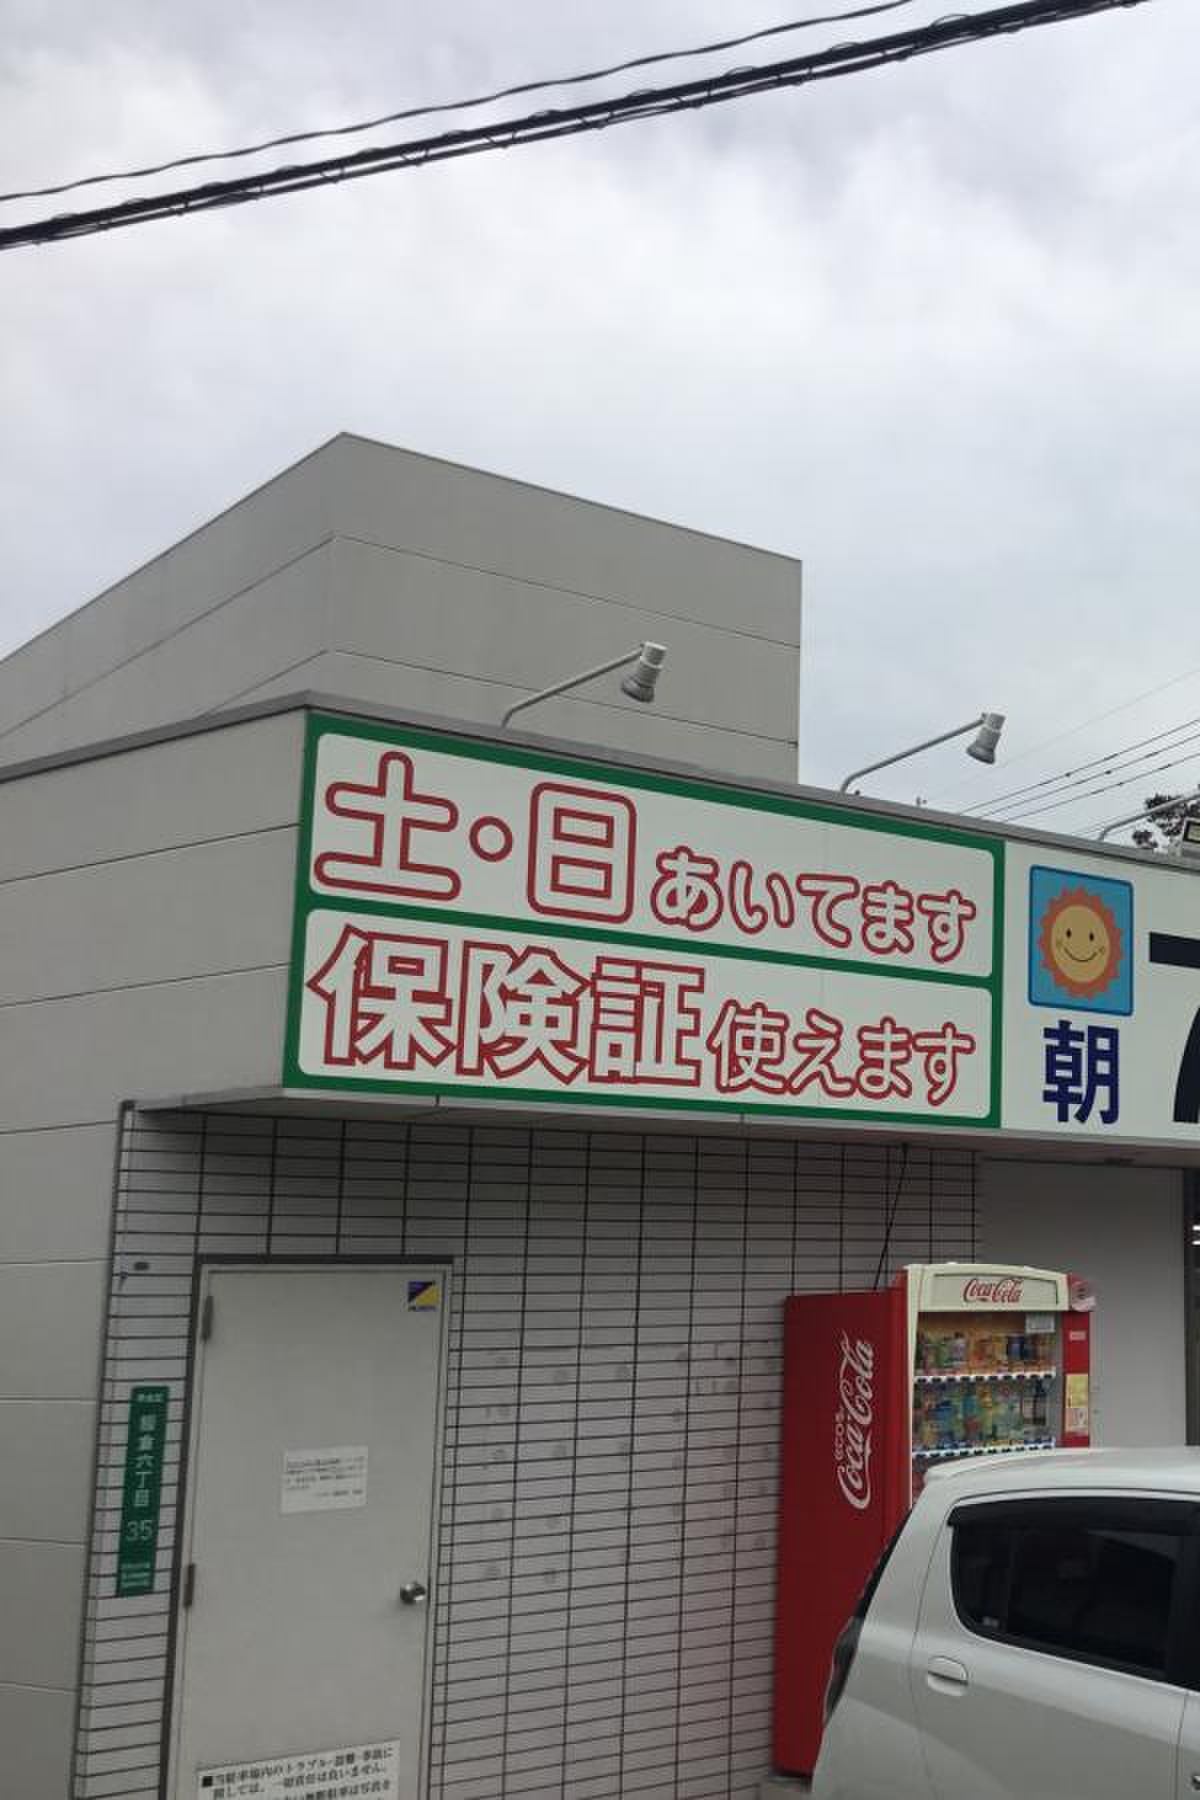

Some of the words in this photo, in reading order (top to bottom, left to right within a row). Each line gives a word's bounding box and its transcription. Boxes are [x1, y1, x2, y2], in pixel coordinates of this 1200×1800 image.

[306, 923, 976, 1105] 保険証使えます
[837, 1330, 874, 1509] Coca-Cola
[126, 1519, 153, 1541] 35
